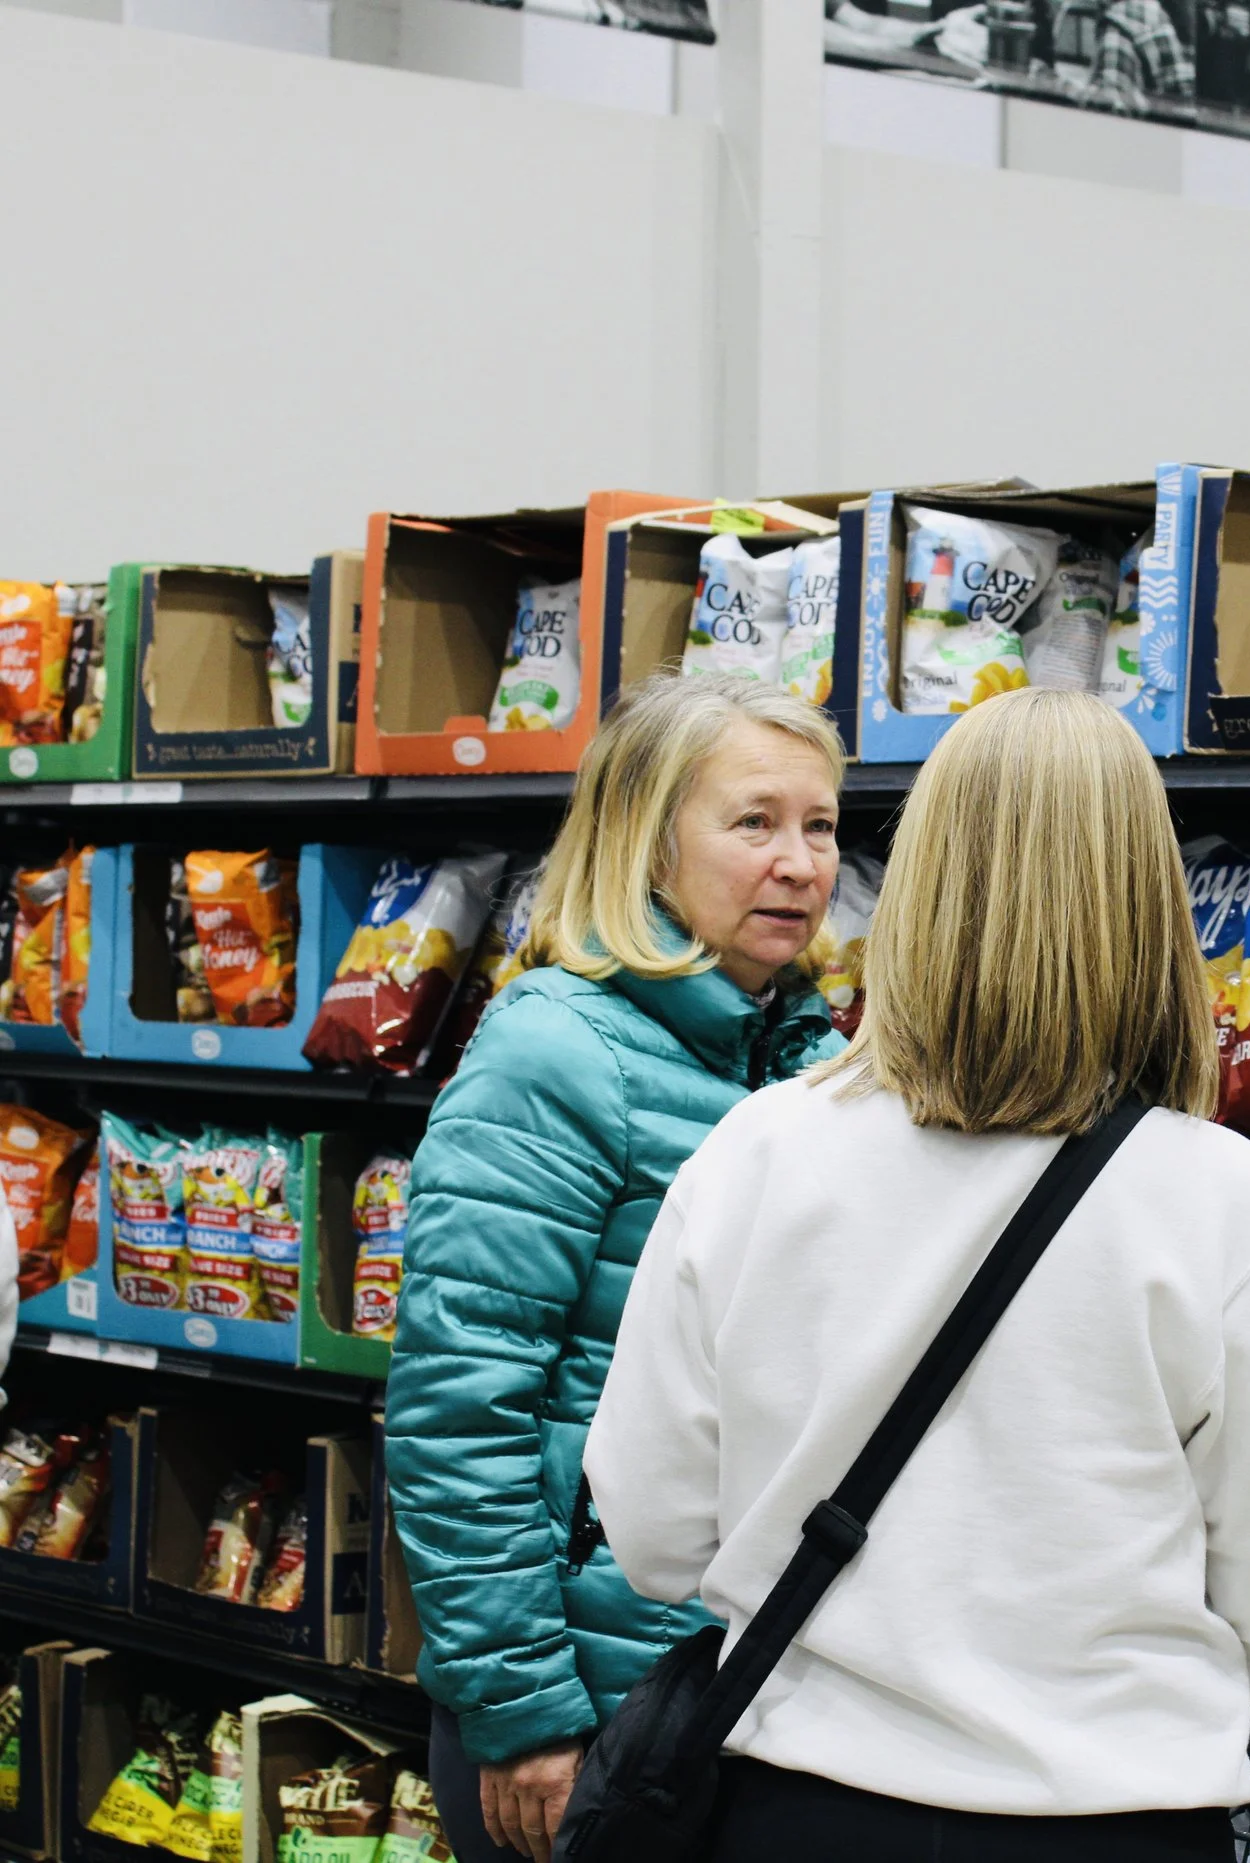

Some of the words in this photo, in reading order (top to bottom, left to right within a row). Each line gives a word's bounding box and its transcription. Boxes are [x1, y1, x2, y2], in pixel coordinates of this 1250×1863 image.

[1150, 510, 1172, 565] PARTY
[962, 561, 1036, 604] CAPE
[519, 610, 566, 636] CAPE
[863, 616, 876, 697] ENJOY
